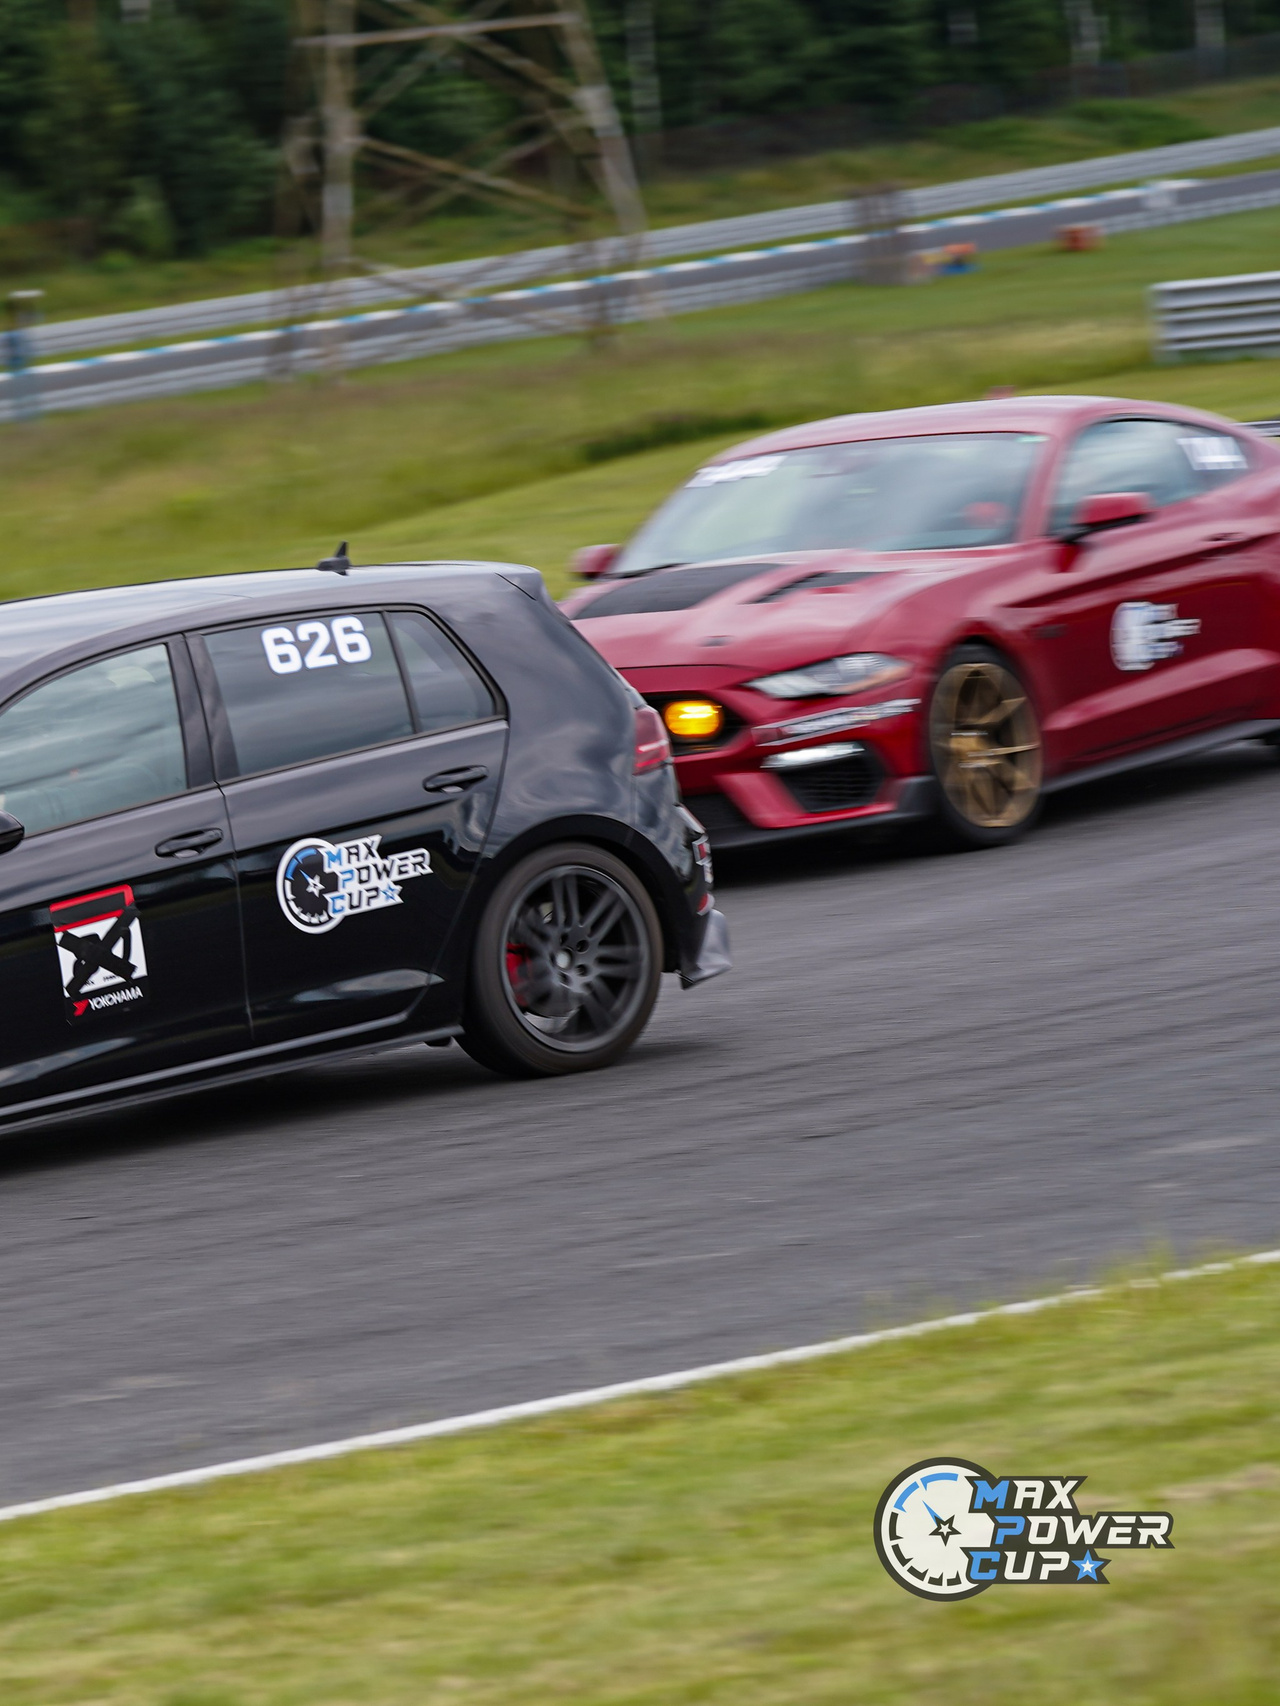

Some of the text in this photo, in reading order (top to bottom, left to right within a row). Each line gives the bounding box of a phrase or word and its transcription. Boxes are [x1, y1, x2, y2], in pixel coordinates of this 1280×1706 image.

[261, 615, 372, 674] 626
[326, 840, 376, 868] MAX
[339, 852, 428, 889] POWER
[330, 887, 380, 914] CUP
[88, 986, 143, 1010] YOKOHAMA
